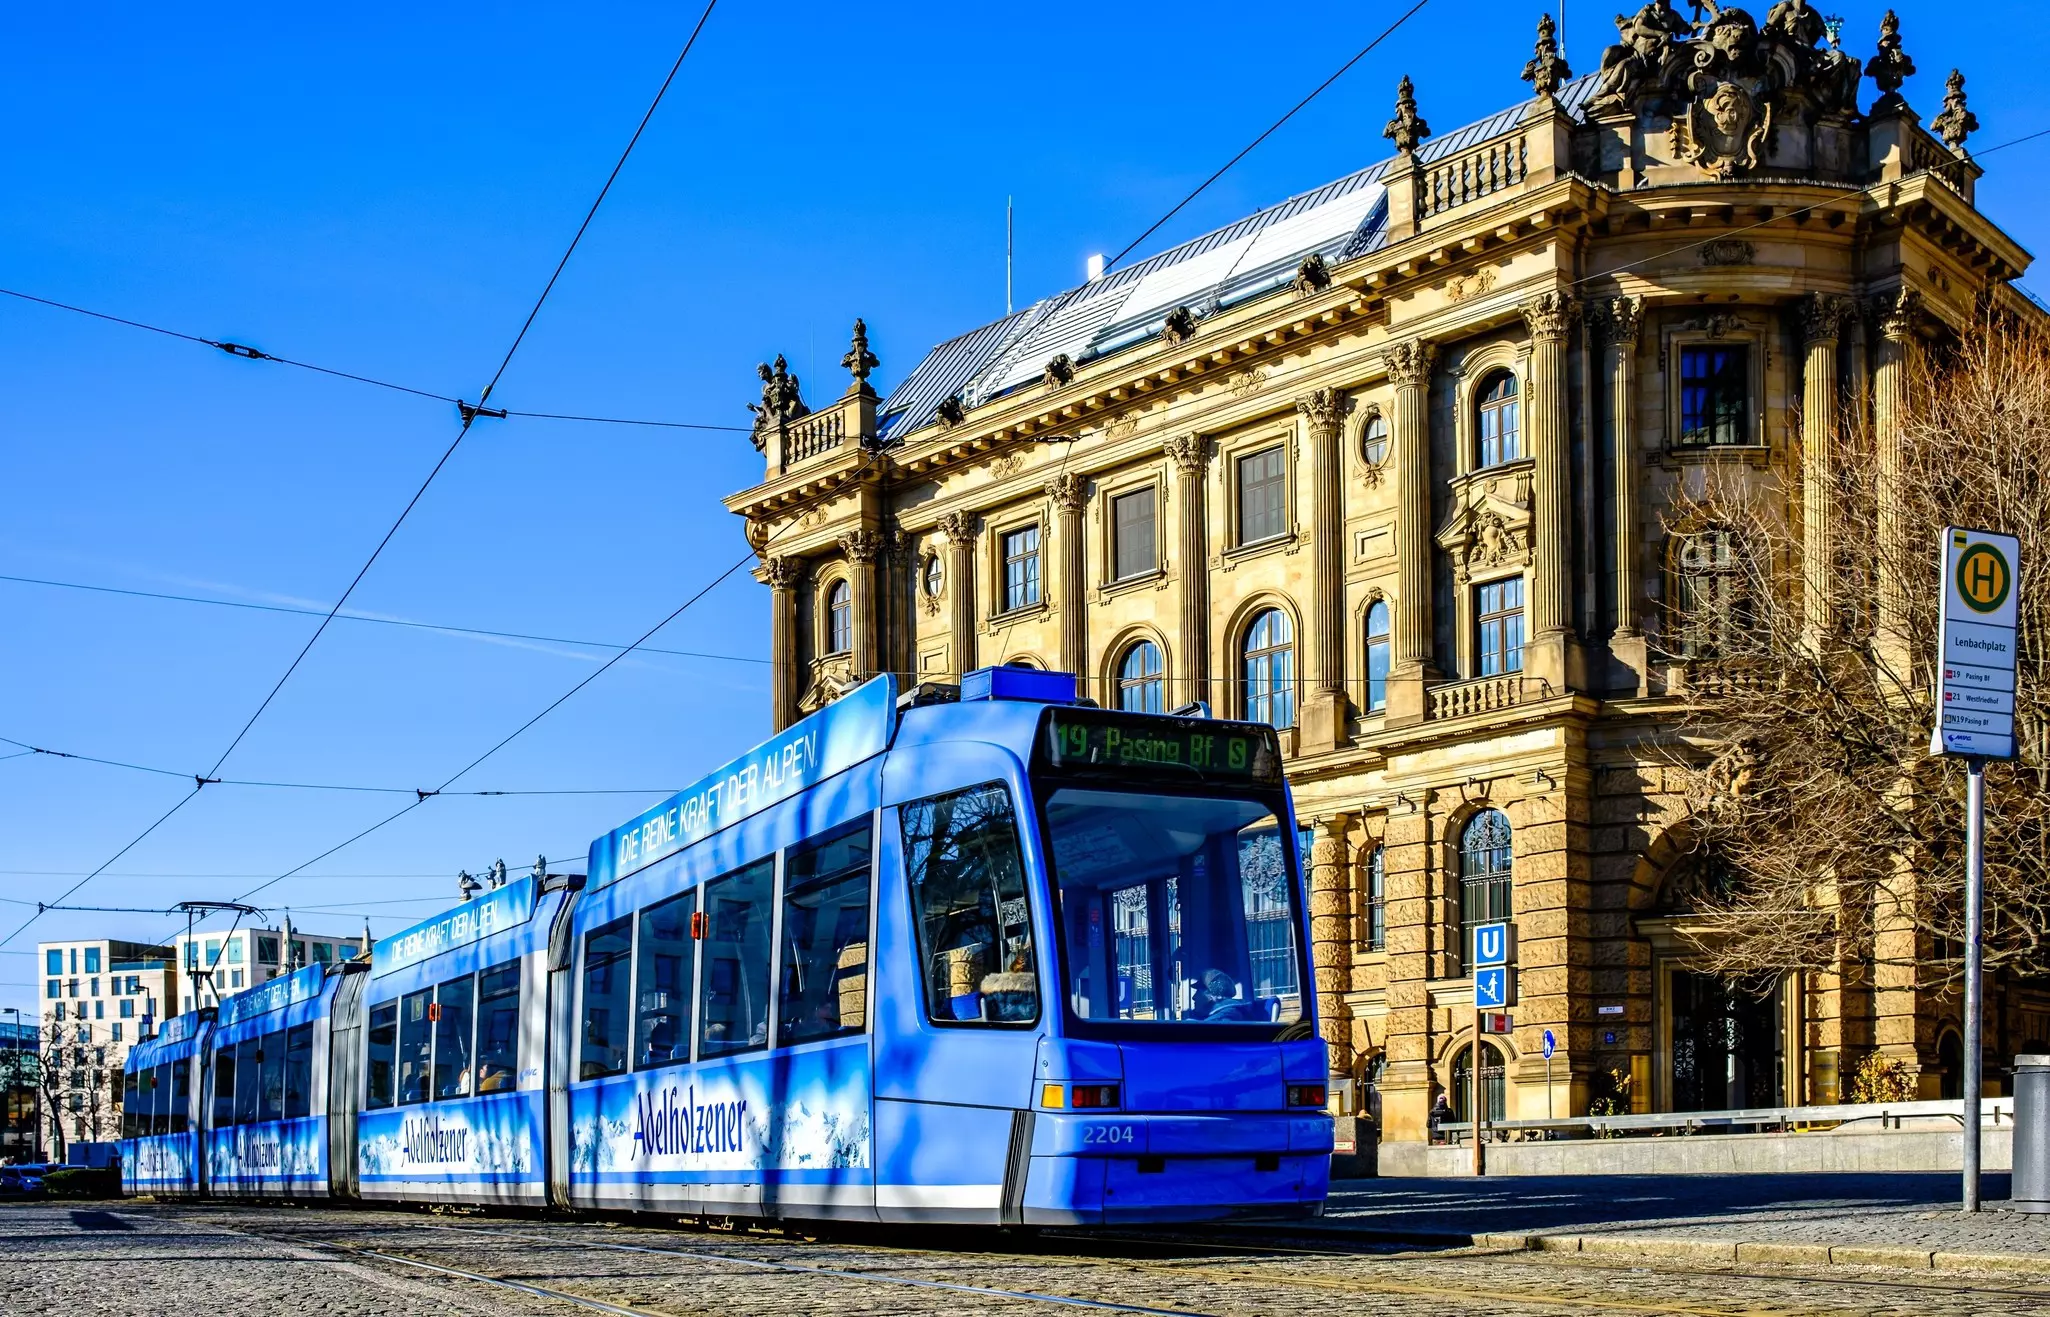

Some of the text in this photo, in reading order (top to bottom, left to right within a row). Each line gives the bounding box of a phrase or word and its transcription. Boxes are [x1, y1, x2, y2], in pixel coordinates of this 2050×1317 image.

[1972, 558, 1995, 598] H
[1955, 636, 2006, 652] Lenbachplatz
[1953, 670, 1961, 678] 19
[1966, 673, 1983, 682] Pasing
[1966, 695, 1999, 704] Westfriedhof
[1952, 715, 1964, 723] N19
[1965, 717, 1981, 726] Pasing
[1058, 724, 1087, 756] 19
[1106, 727, 1180, 762] Pasing
[620, 730, 818, 865] DIE REINE KRAFT DER ALPEN.
[392, 939, 404, 962] DIE
[425, 918, 451, 949] KRAFT
[451, 911, 469, 940] DER
[1482, 930, 1499, 959] U
[631, 1084, 747, 1162] Adelholzener
[1083, 1125, 1134, 1144] 2204
[401, 1115, 468, 1168] Adelholzener
